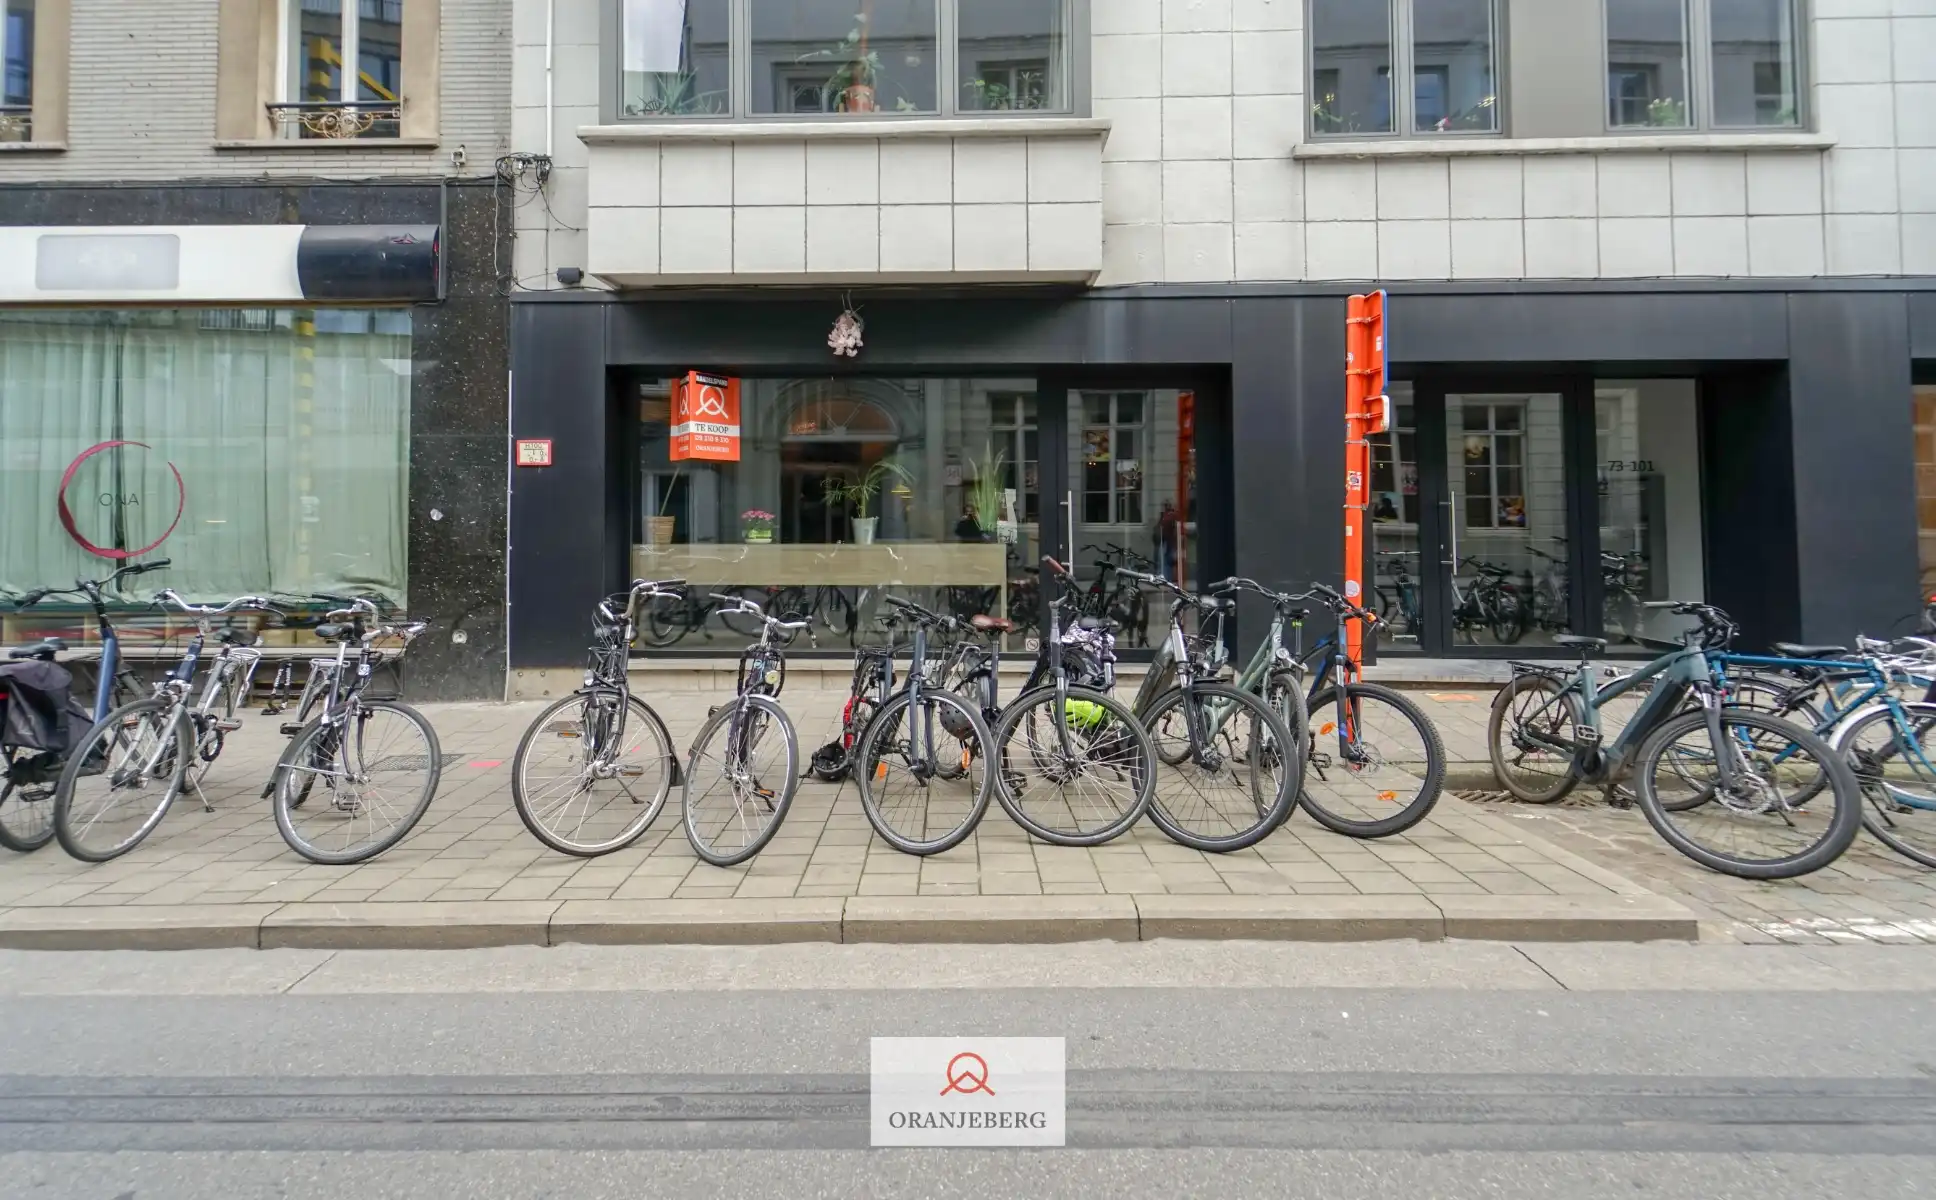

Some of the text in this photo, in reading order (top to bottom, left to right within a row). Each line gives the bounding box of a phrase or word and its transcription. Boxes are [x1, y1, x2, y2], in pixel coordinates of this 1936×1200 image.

[695, 423, 706, 432] TE
[707, 424, 729, 434] KOOP
[99, 492, 140, 507] ONA
